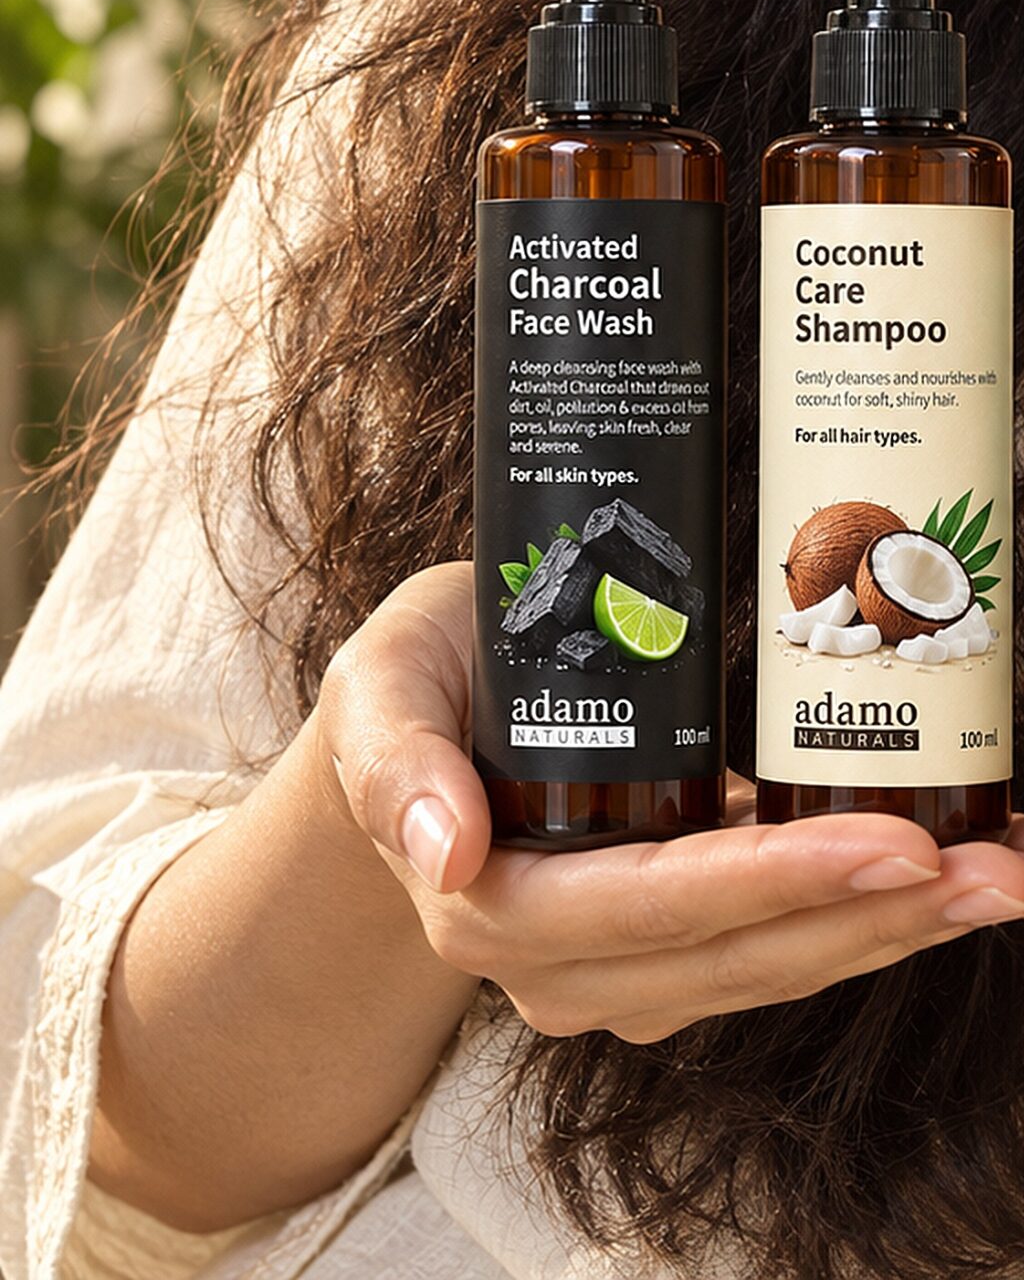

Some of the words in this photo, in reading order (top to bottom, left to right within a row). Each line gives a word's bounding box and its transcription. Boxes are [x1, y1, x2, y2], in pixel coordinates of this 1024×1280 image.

[509, 234, 638, 259] Activated
[796, 239, 924, 266] Coconut
[509, 267, 662, 300] Charcoal
[796, 276, 865, 304] Care
[510, 309, 570, 335] Face
[577, 308, 653, 335] Wash
[795, 313, 947, 350] Shampoo
[509, 360, 518, 374] A
[619, 360, 646, 375] face
[795, 370, 832, 388] Gently
[835, 370, 891, 385] cleanses
[893, 371, 918, 385] and
[921, 370, 976, 385] nourishes
[795, 392, 841, 407] coconut
[844, 391, 861, 406] for
[864, 392, 893, 408] soft,
[896, 392, 930, 410] shiny
[932, 392, 959, 407] hair.
[509, 439, 533, 453] and
[795, 428, 817, 443] For
[820, 428, 837, 443] all
[840, 428, 871, 443] hair
[874, 429, 922, 447] types.
[510, 468, 533, 483] For
[534, 467, 553, 483] all
[555, 468, 587, 483] skin
[590, 469, 639, 486] types.
[511, 689, 634, 723] adamo
[795, 691, 918, 726] adamo
[514, 729, 630, 744] NATURALS
[798, 731, 914, 747] NATURALS
